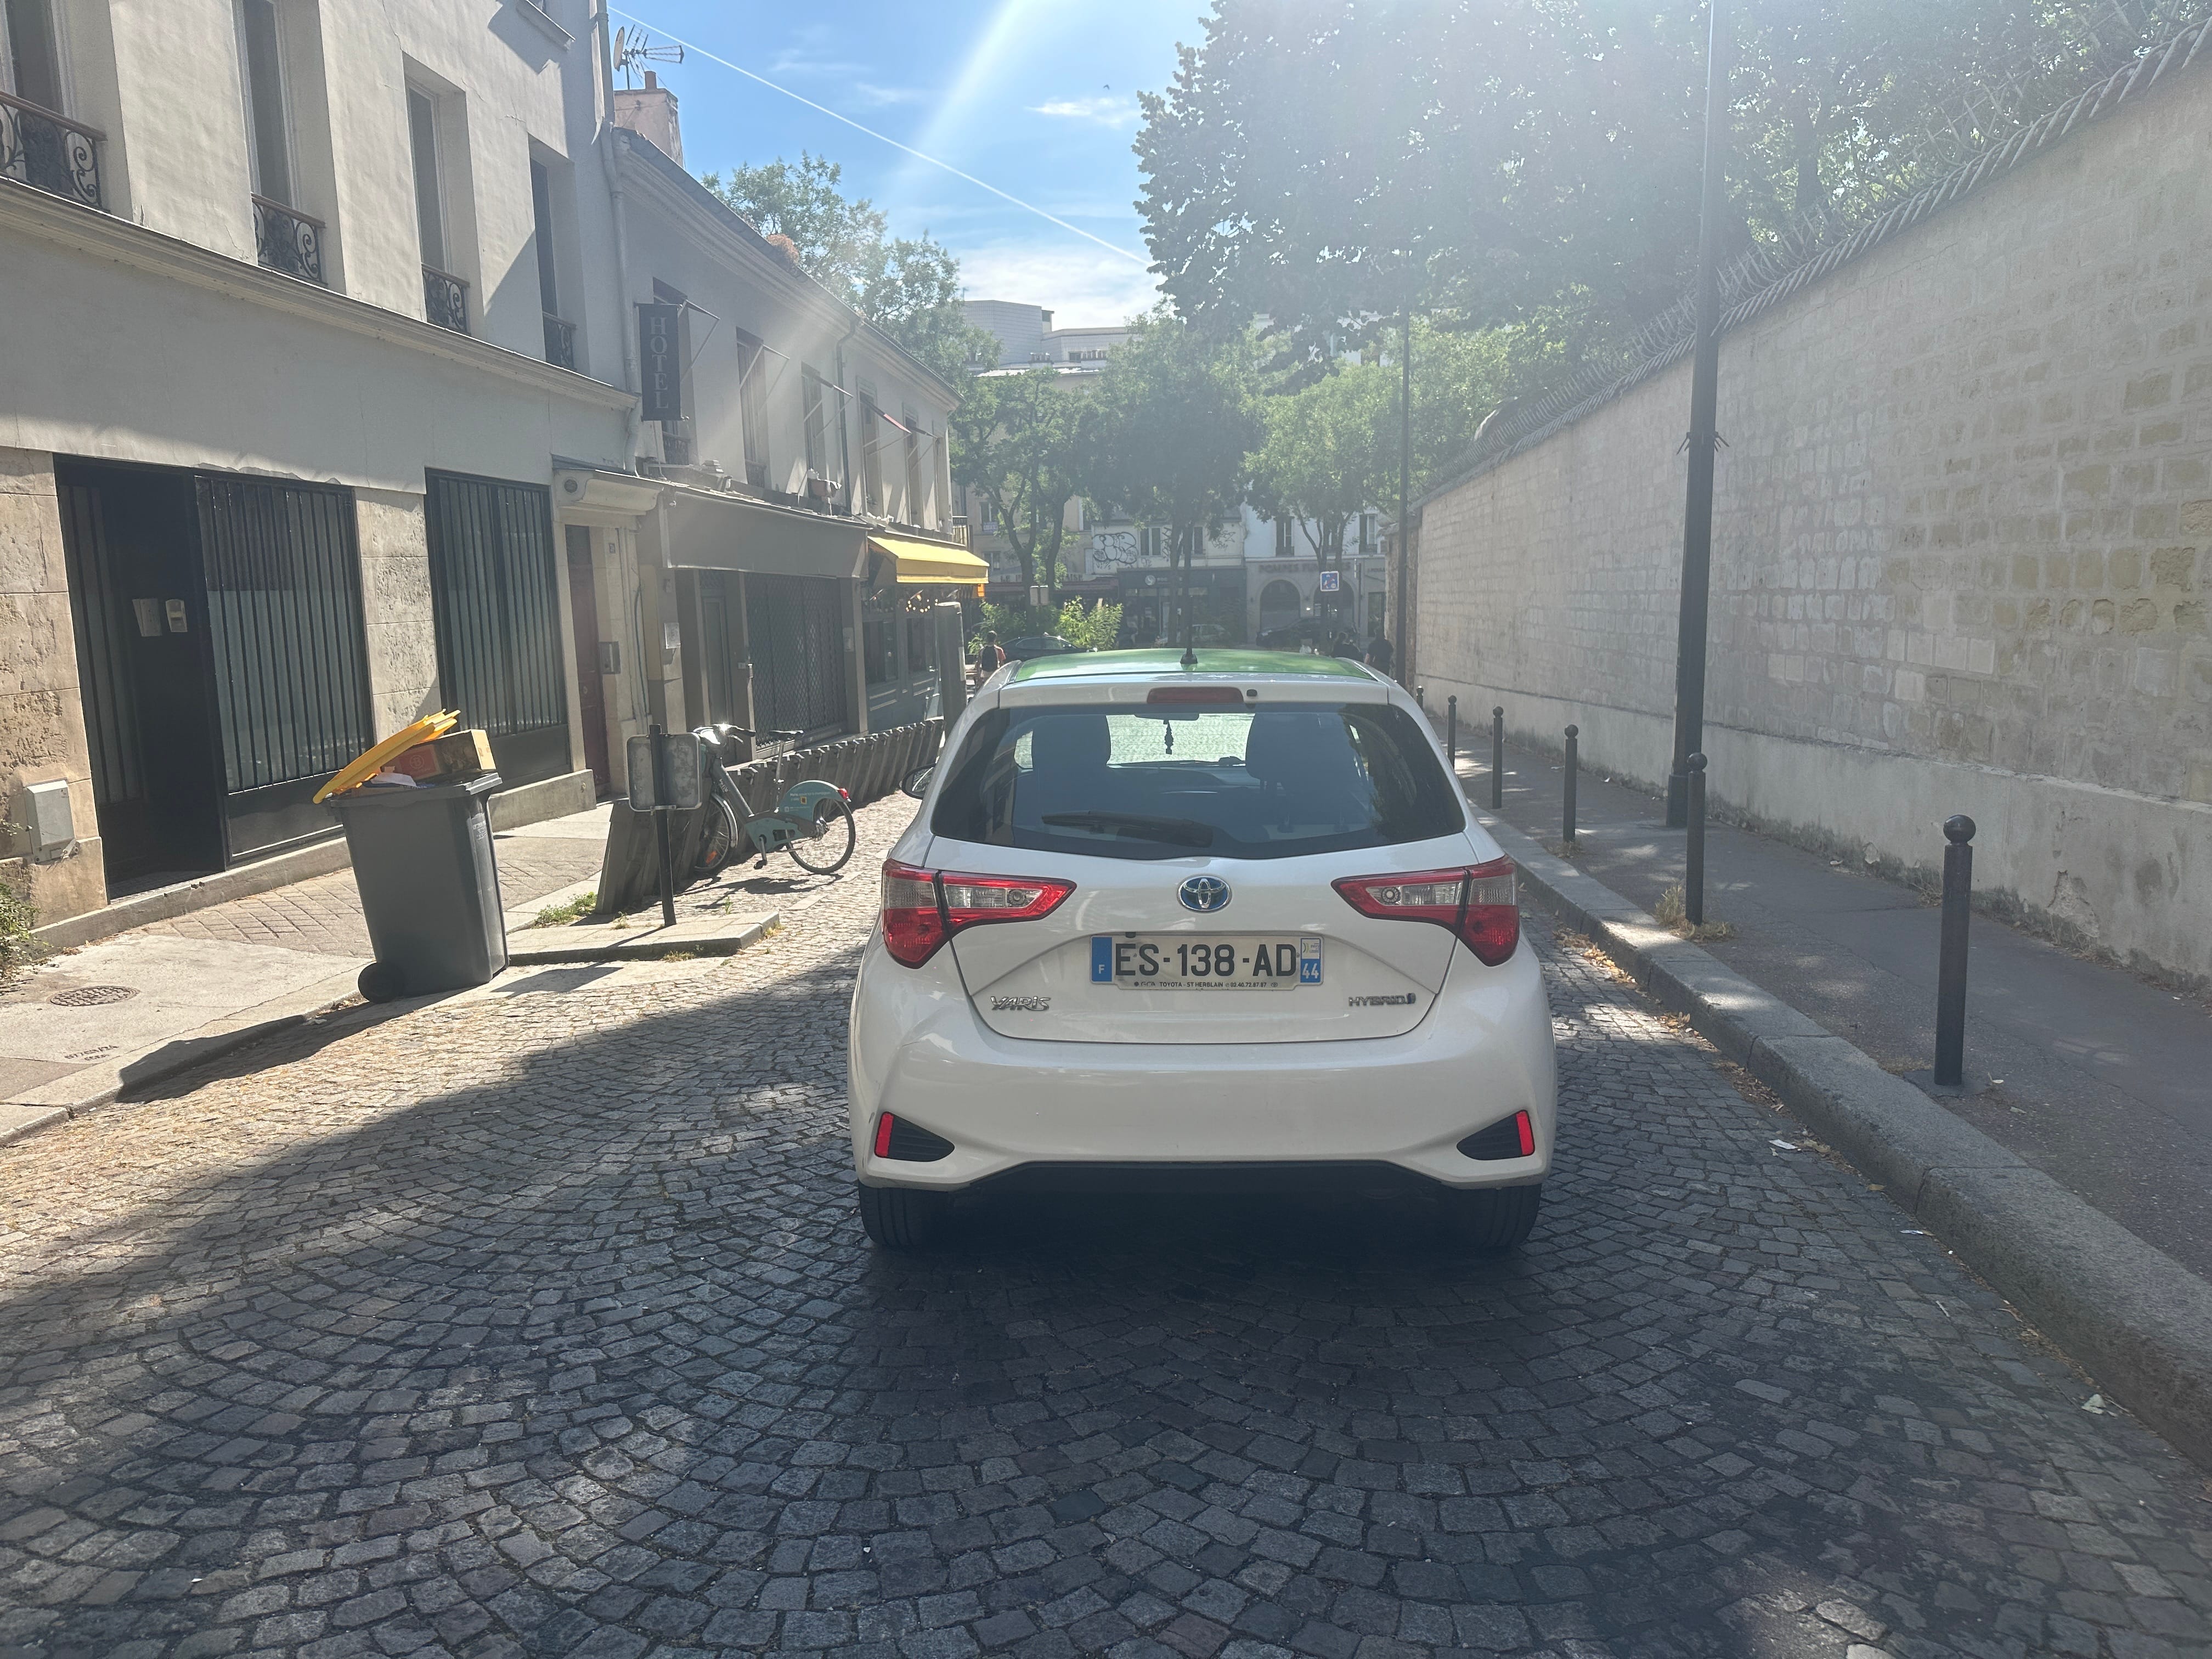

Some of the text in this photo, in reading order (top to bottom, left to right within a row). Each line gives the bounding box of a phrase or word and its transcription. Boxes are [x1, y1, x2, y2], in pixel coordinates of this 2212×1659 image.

[650, 317, 668, 409] HOTEL
[1115, 943, 1296, 977] ES-138-AD
[1098, 964, 1105, 974] F
[1302, 963, 1319, 979] 44
[1348, 995, 1405, 1006] HYBRID
